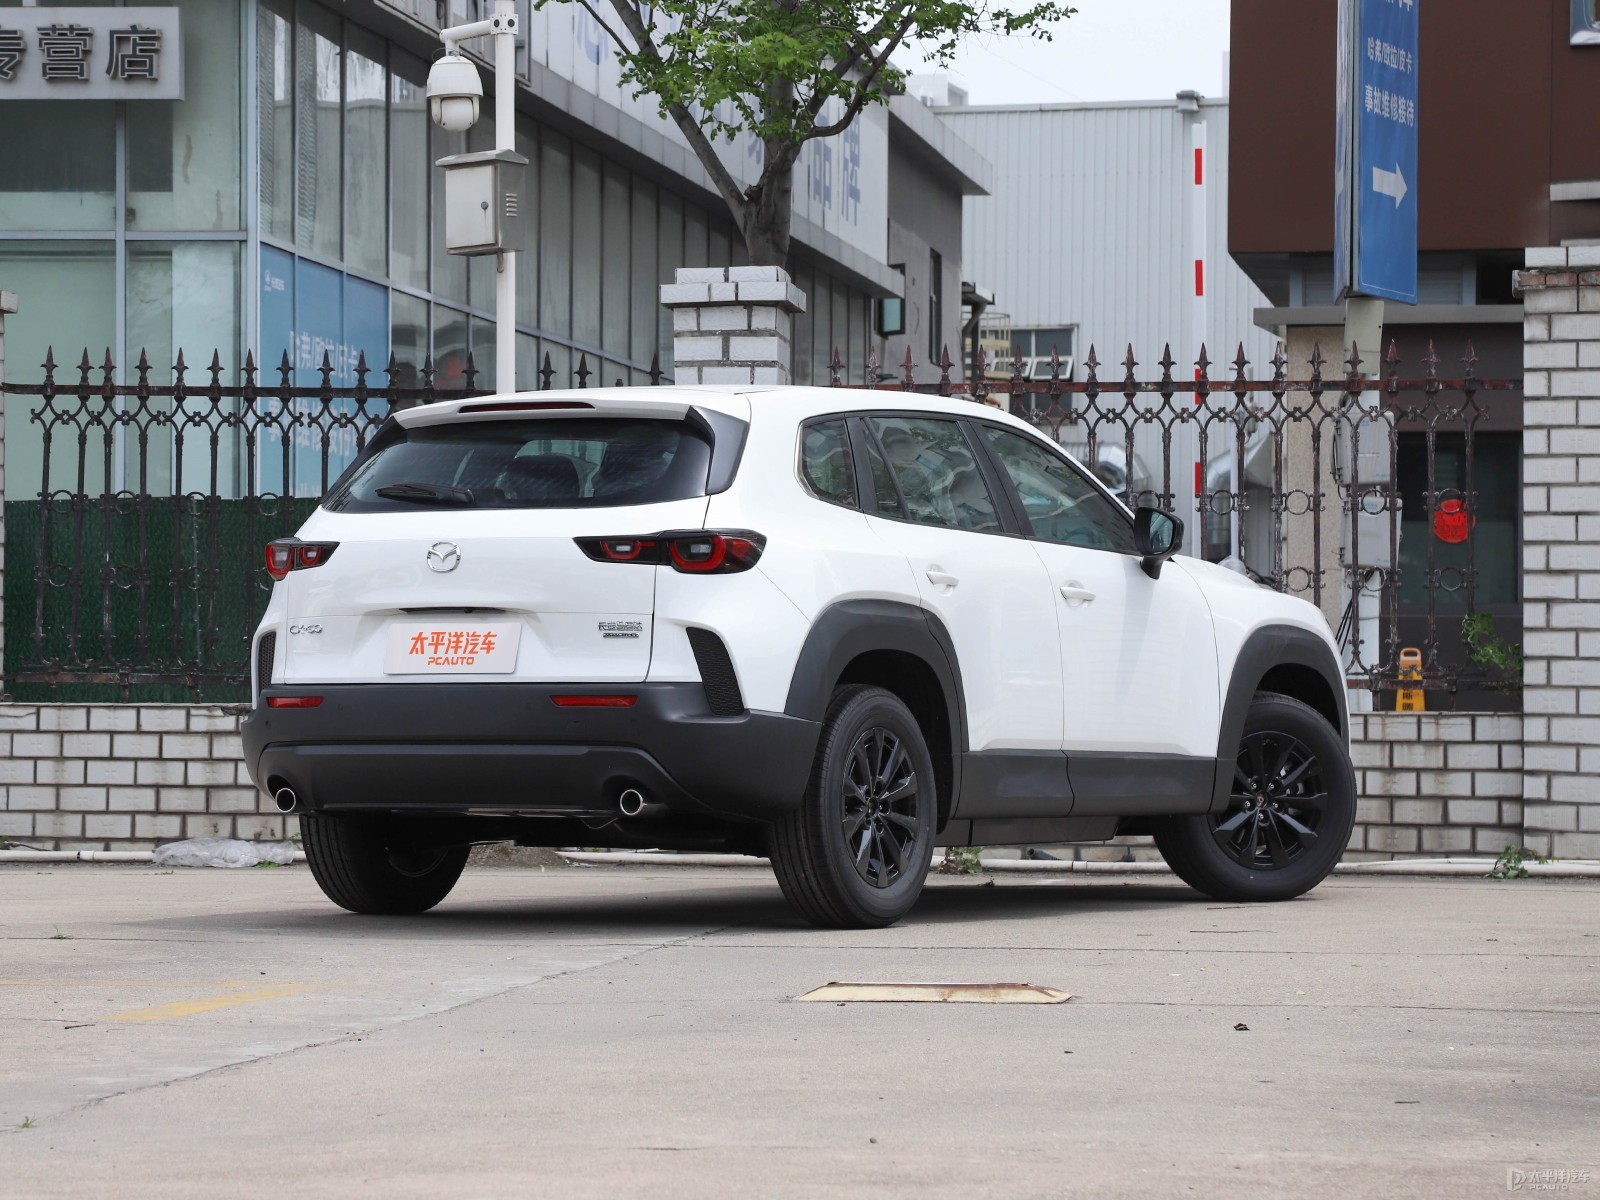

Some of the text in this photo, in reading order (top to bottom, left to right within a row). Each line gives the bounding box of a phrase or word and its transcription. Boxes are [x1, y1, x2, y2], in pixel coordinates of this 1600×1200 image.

[1364, 83, 1415, 128] 事故维修接待
[409, 631, 498, 655] 太平洋汽车
[428, 656, 475, 666] PCAUTO
